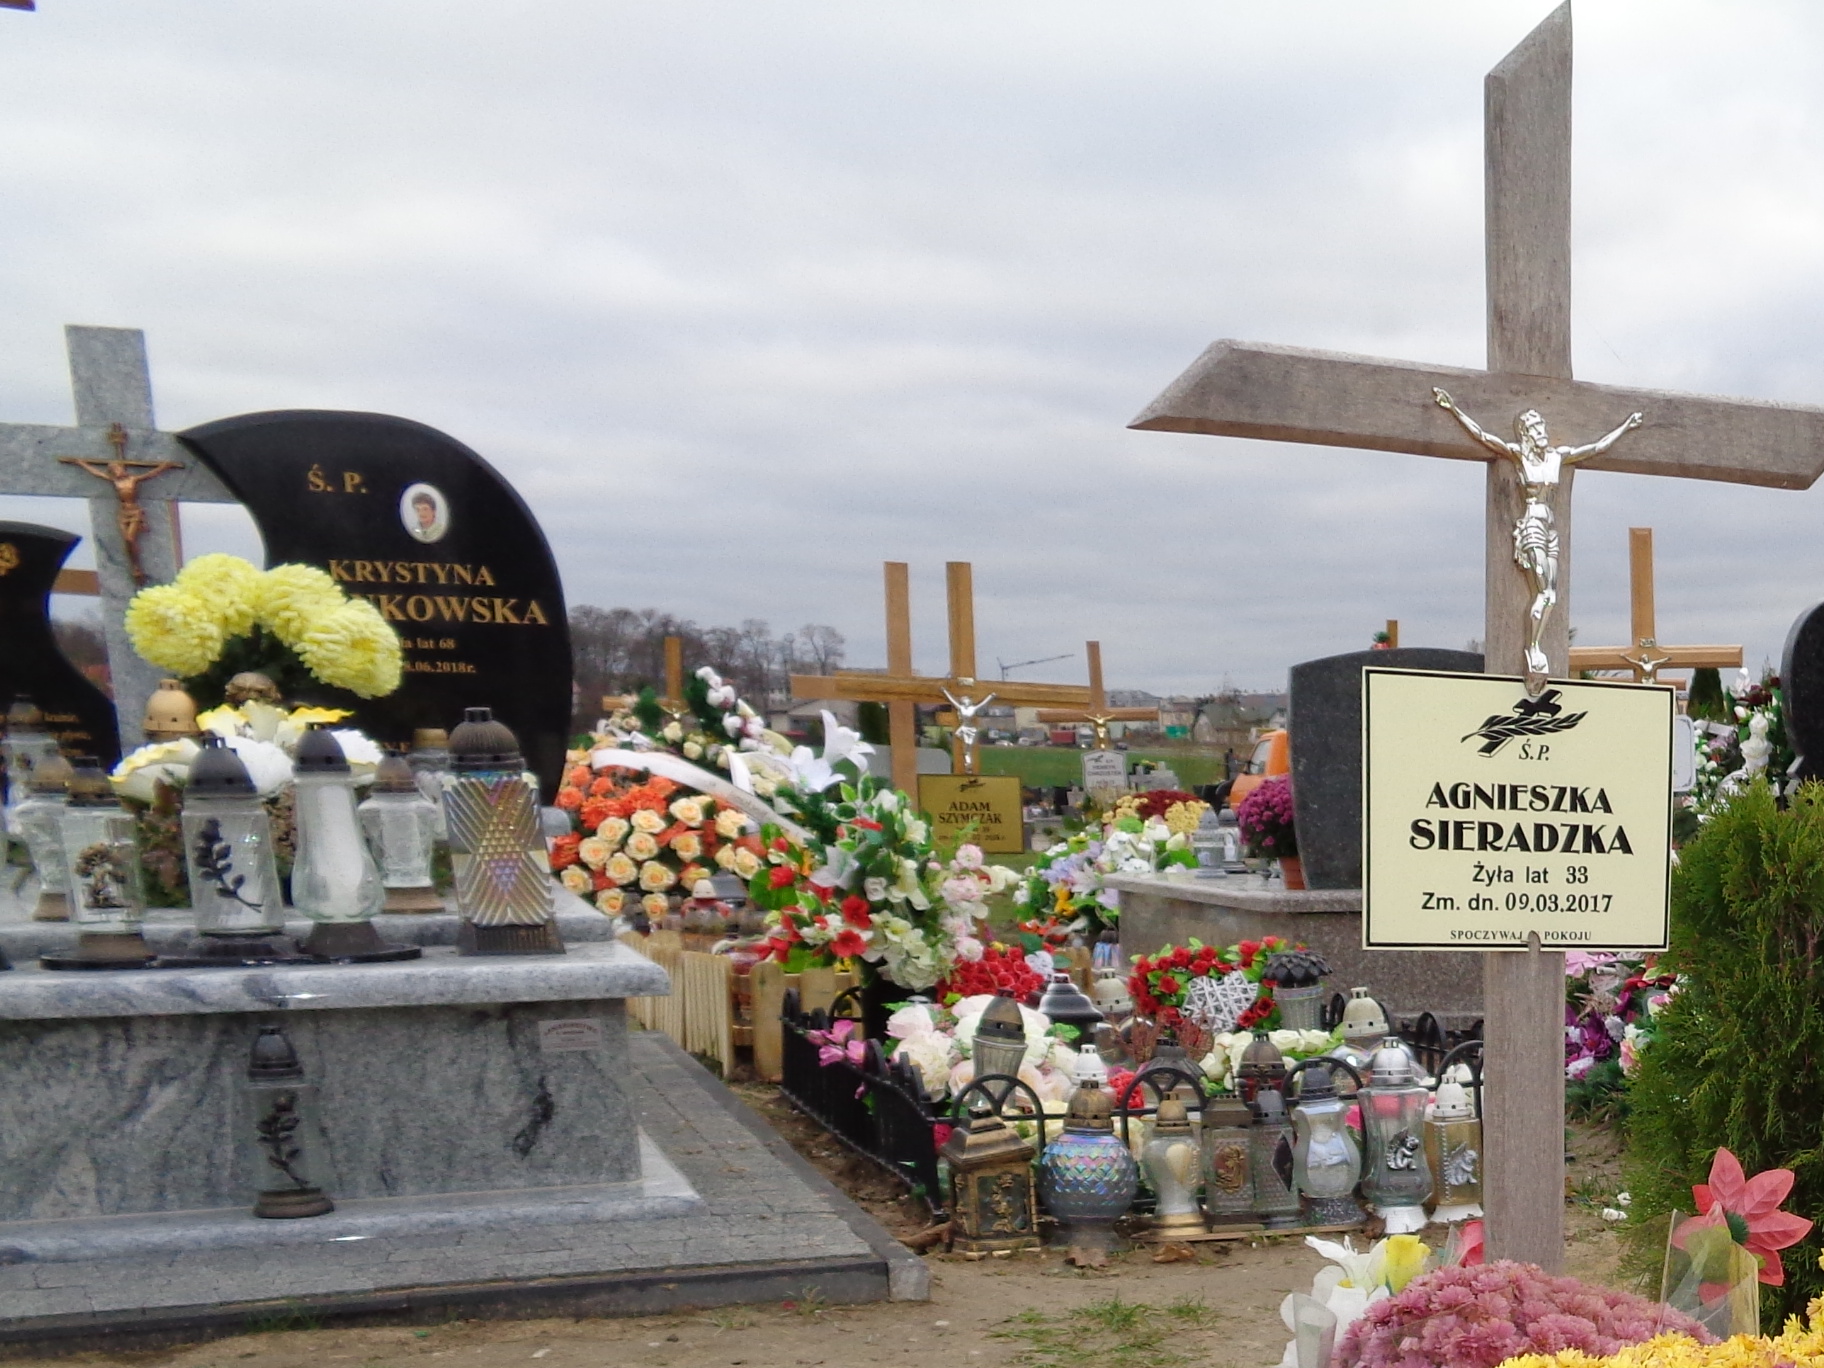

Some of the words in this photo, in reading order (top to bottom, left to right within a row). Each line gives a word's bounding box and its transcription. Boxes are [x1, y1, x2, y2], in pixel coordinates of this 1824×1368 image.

[329, 559, 495, 586] KRYSTYNA
[352, 593, 548, 625] KOWSKA
[949, 801, 991, 812] ADAM
[1425, 781, 1613, 814] AGNIESZKA
[1409, 818, 1634, 856] SIERADZKA
[1472, 861, 1514, 887] Żyła
[1526, 866, 1549, 884] lat
[1565, 865, 1589, 884] 33
[1421, 892, 1460, 911] Zm.
[1468, 893, 1499, 911] dn.
[1505, 892, 1613, 913] 09.03.2017
[1450, 930, 1523, 941] SPOCZYWAJ
[1544, 931, 1592, 941] POKOJU
